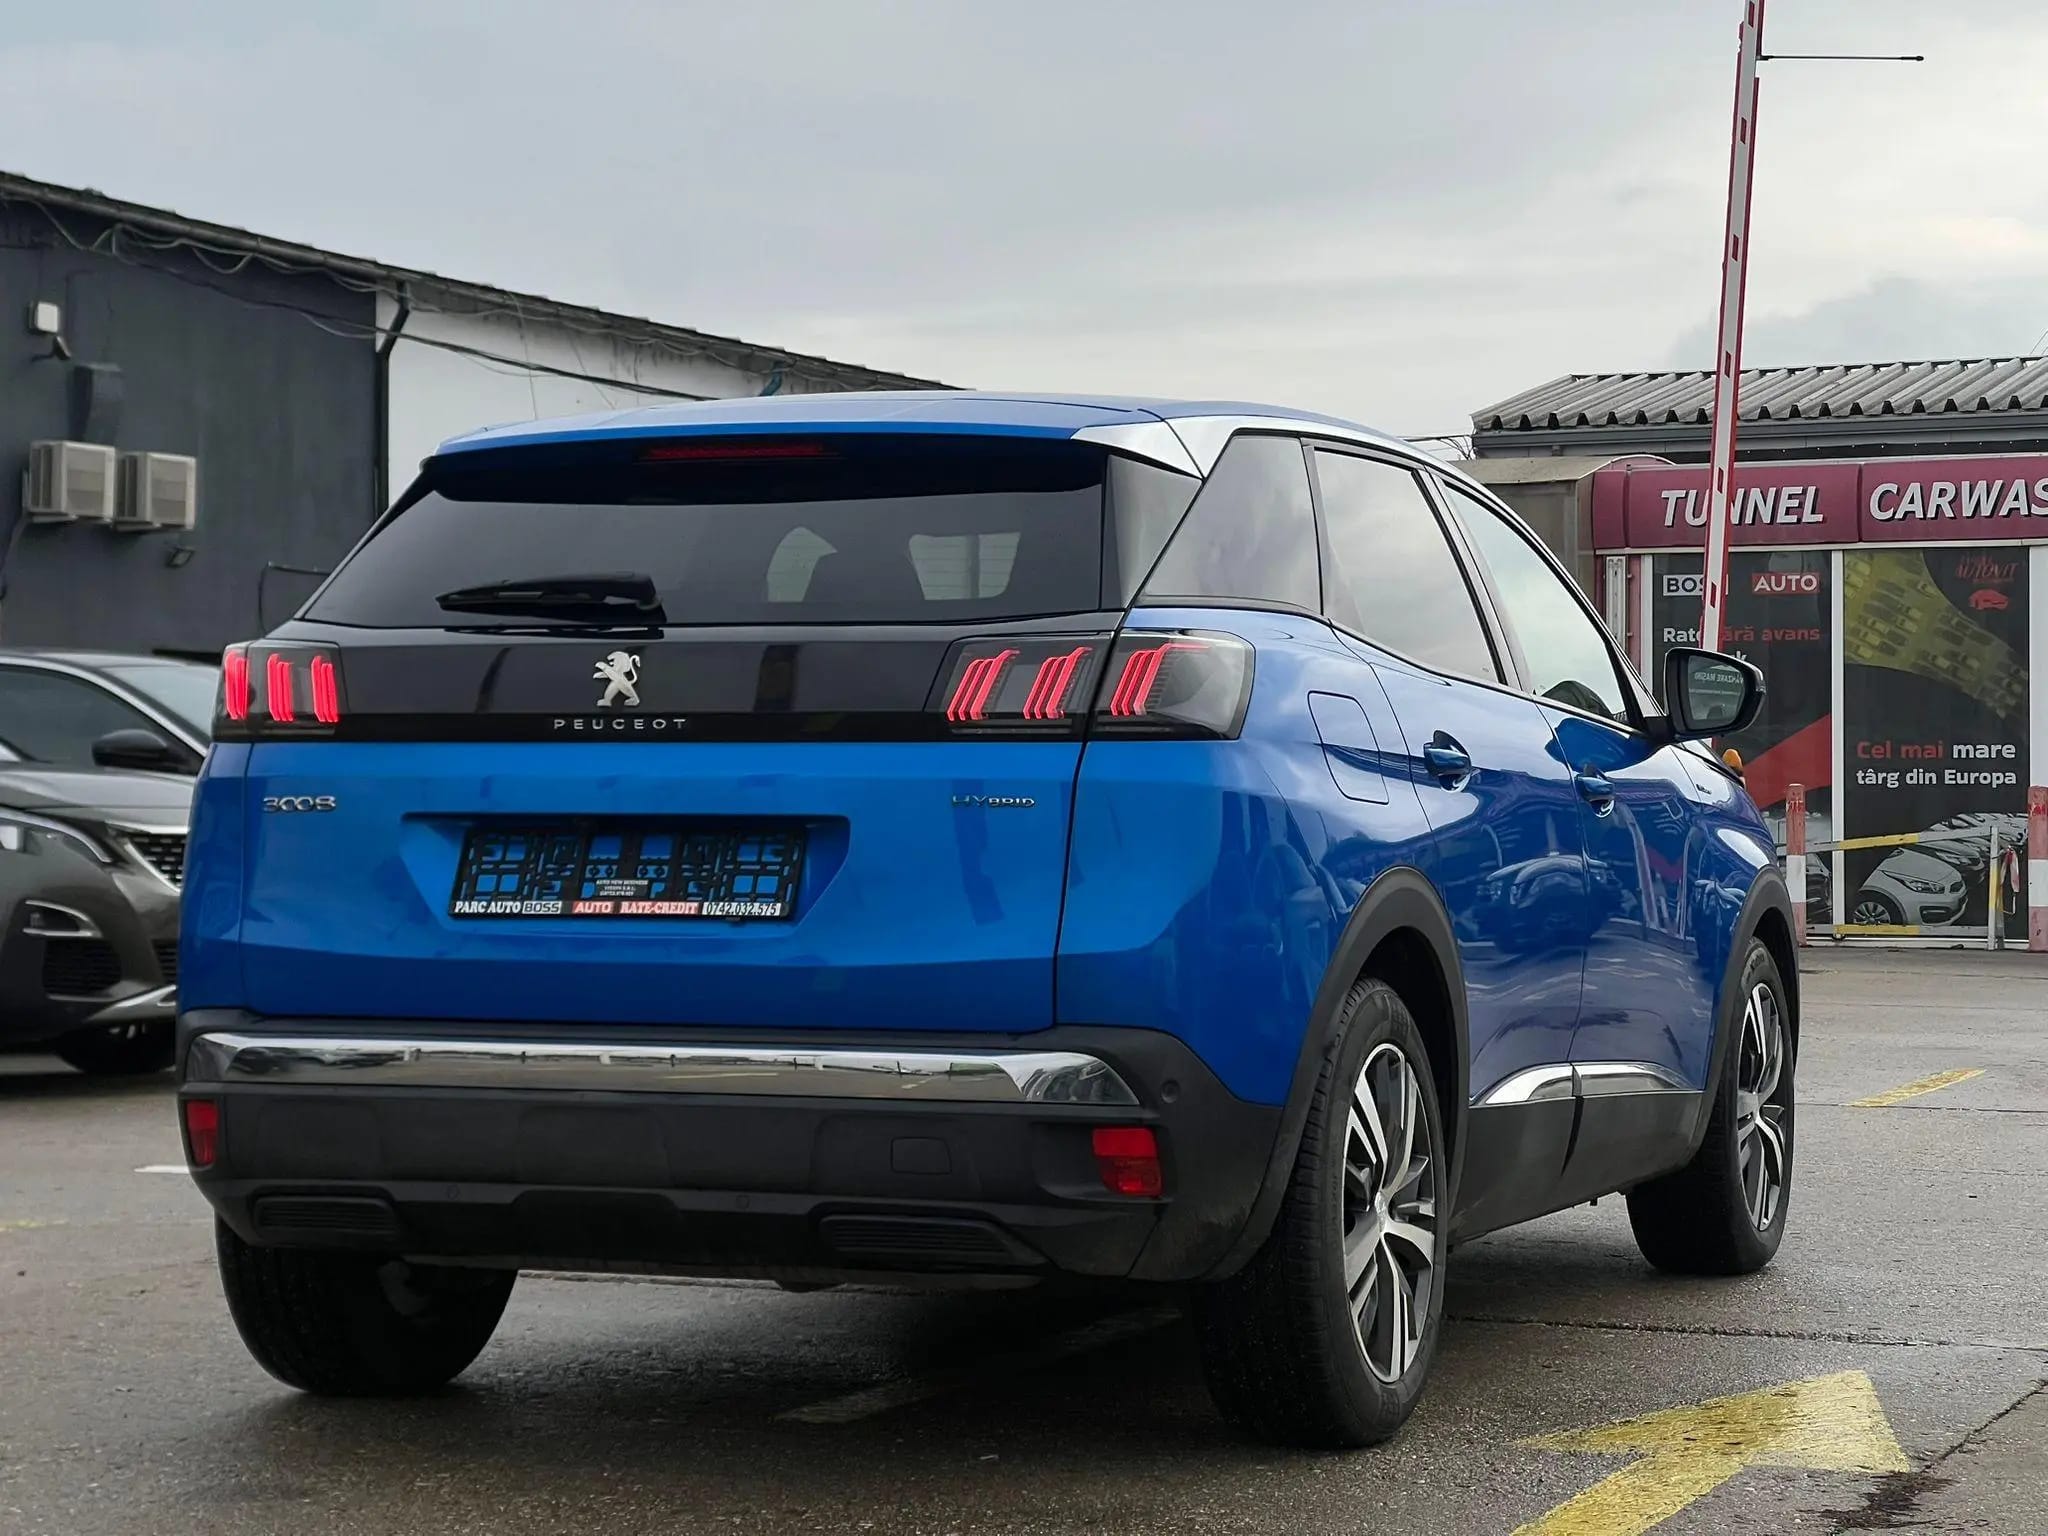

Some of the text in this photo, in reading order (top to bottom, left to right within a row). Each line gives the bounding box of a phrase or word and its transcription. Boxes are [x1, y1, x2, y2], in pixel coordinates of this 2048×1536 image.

[1754, 575, 1818, 592] AUTO
[1761, 627, 1820, 642] avans
[553, 718, 687, 730] PEUGEOT
[1856, 740, 2017, 760] Cel mai mare
[1855, 768, 2017, 788] târg din Europa
[262, 795, 337, 813] 3008
[952, 794, 1036, 807] HYBRID
[454, 900, 487, 914] PARC
[487, 900, 522, 914] AUTO
[524, 901, 560, 914] BOSS
[574, 901, 611, 914] AUTO
[620, 900, 699, 914] RATE-CREDIT
